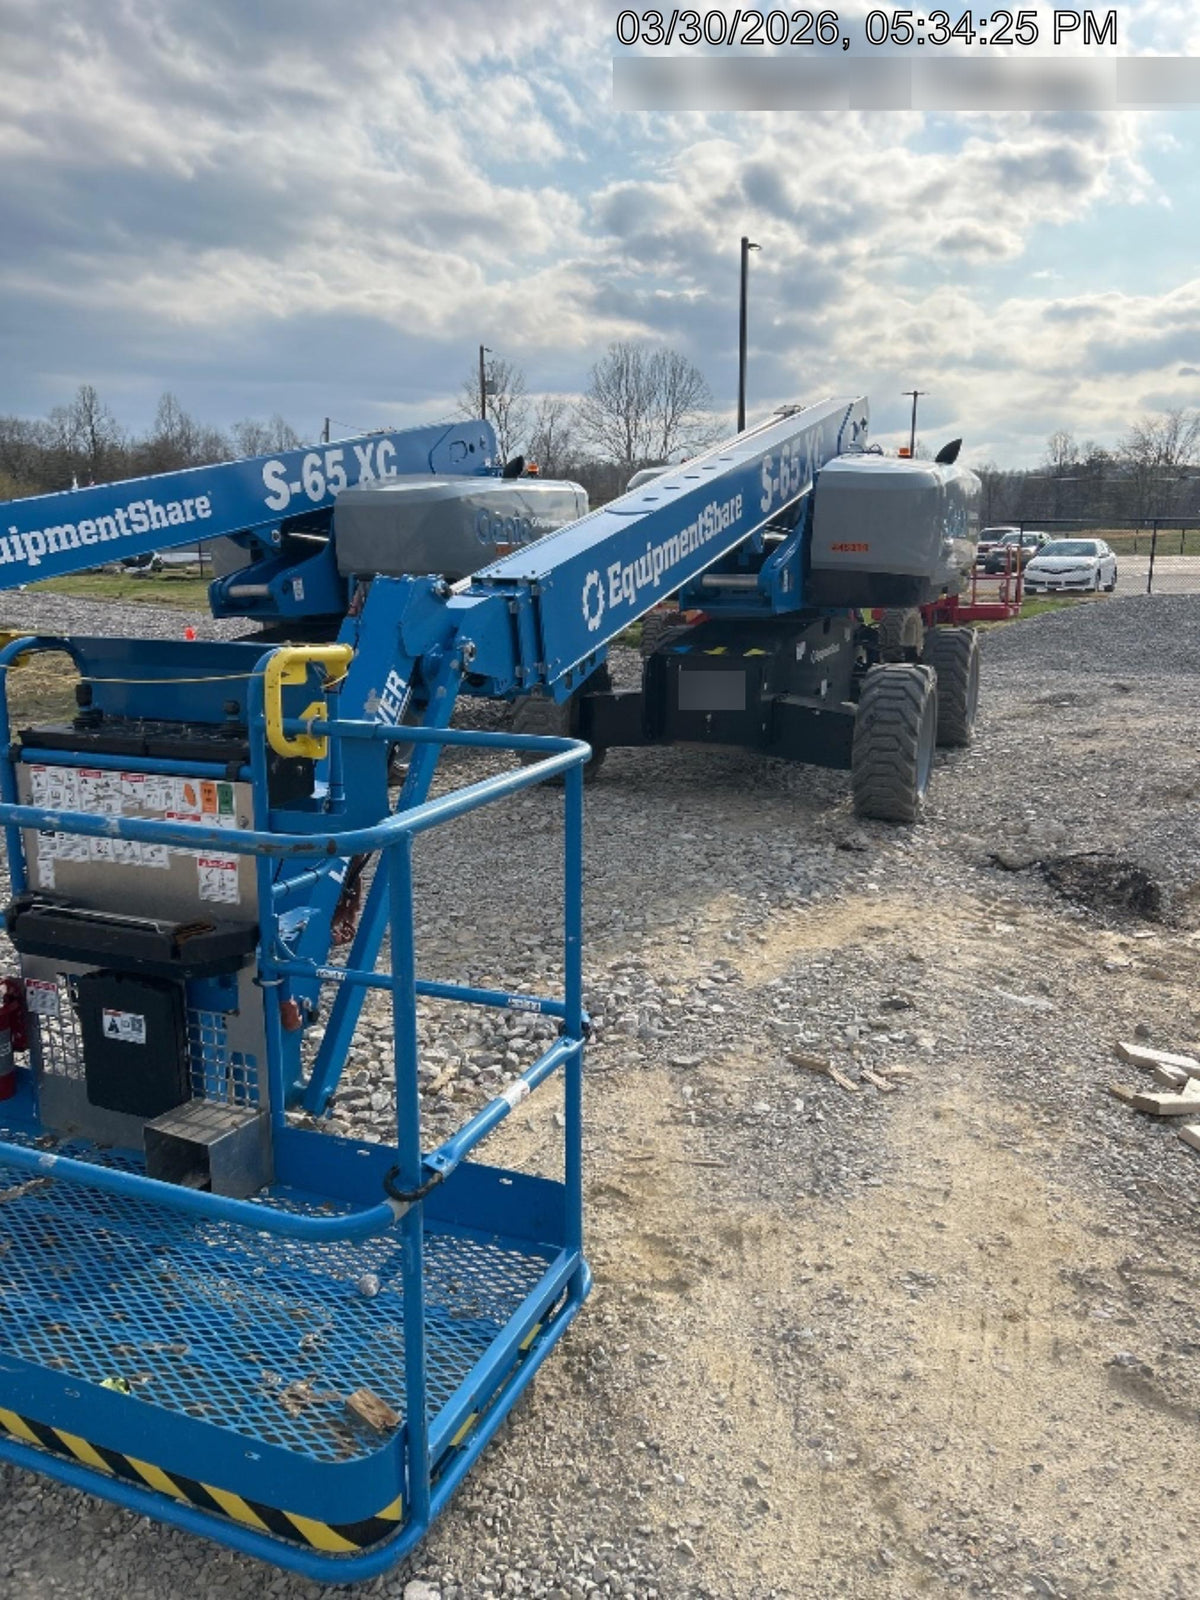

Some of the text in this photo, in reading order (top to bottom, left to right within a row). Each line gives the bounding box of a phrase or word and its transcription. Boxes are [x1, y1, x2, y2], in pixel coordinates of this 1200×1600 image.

[262, 439, 397, 511] S-65 XC
[760, 437, 801, 512] S-65
[607, 494, 742, 608] EquipmentShare
